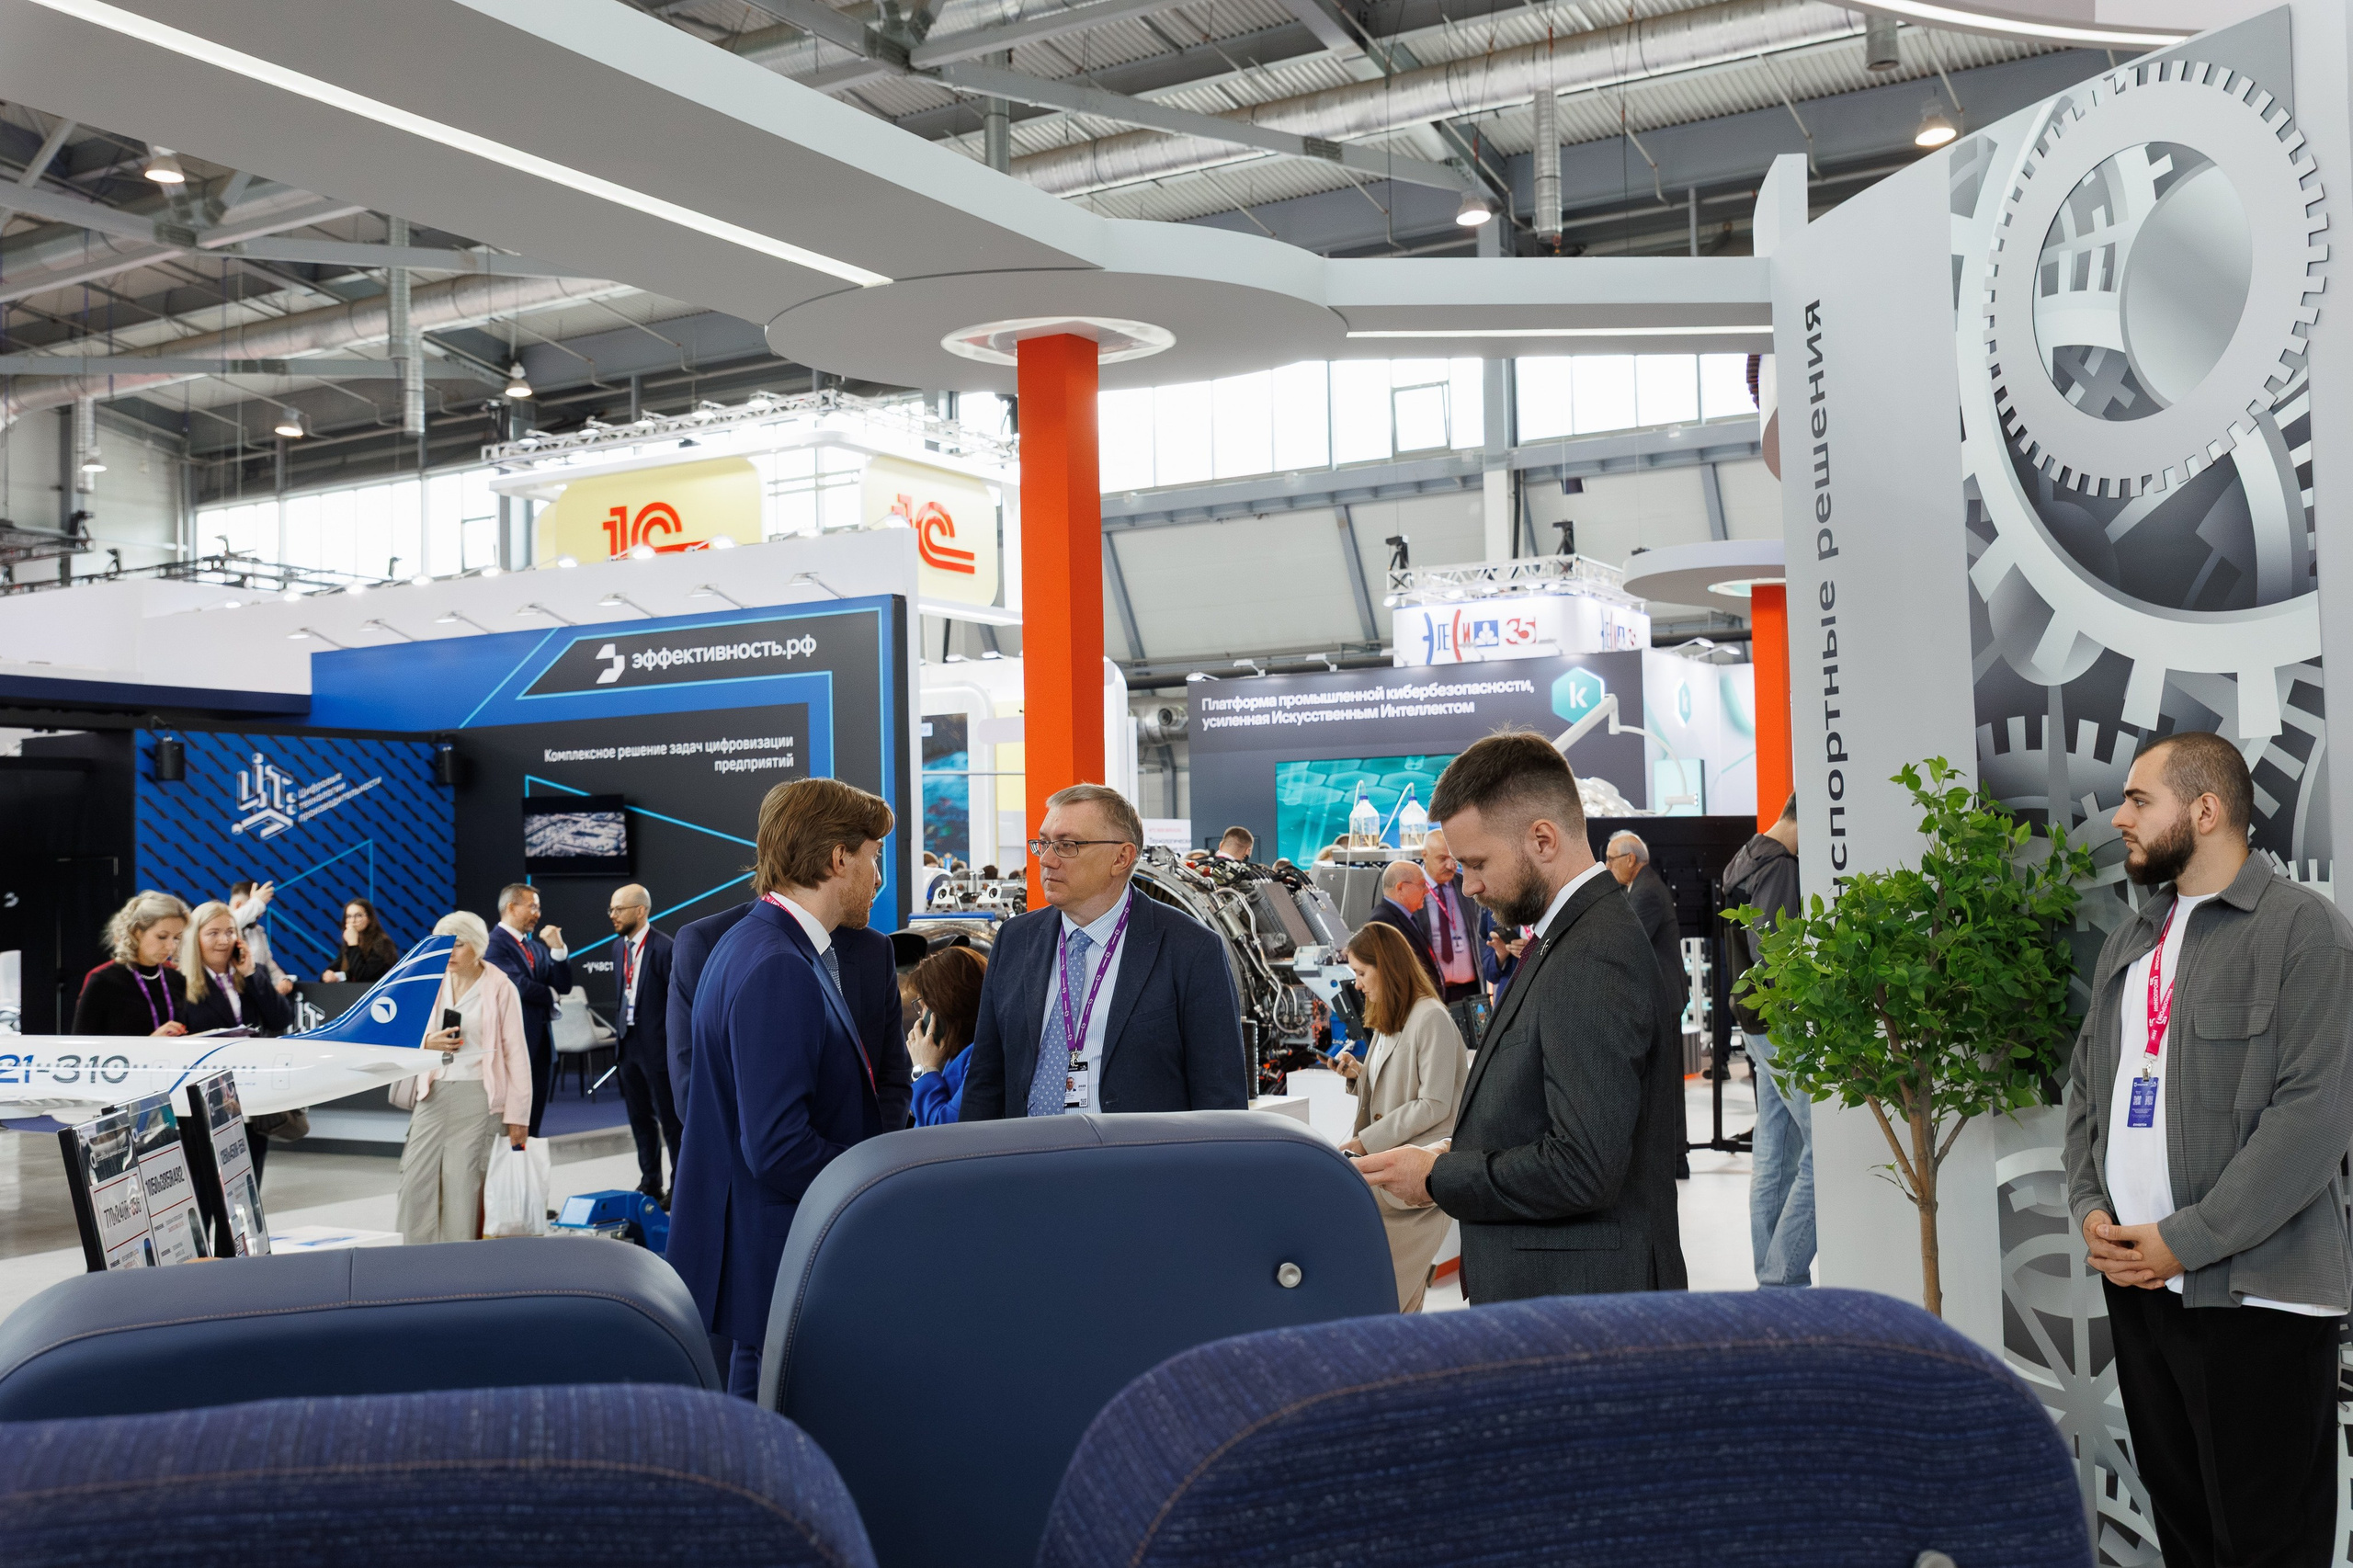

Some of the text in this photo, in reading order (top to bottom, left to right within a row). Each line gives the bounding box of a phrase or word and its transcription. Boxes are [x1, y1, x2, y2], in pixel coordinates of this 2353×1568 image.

[1804, 299, 1839, 561] решения
[631, 634, 817, 671] эффективность.рф
[1201, 679, 1535, 712] Платформа промышленной кибербезопасности,
[1201, 700, 1475, 732] усиленная Искусственным Интеллектом
[544, 735, 793, 763] Комплексное решение задач цифровизации
[714, 753, 794, 774] предприятий
